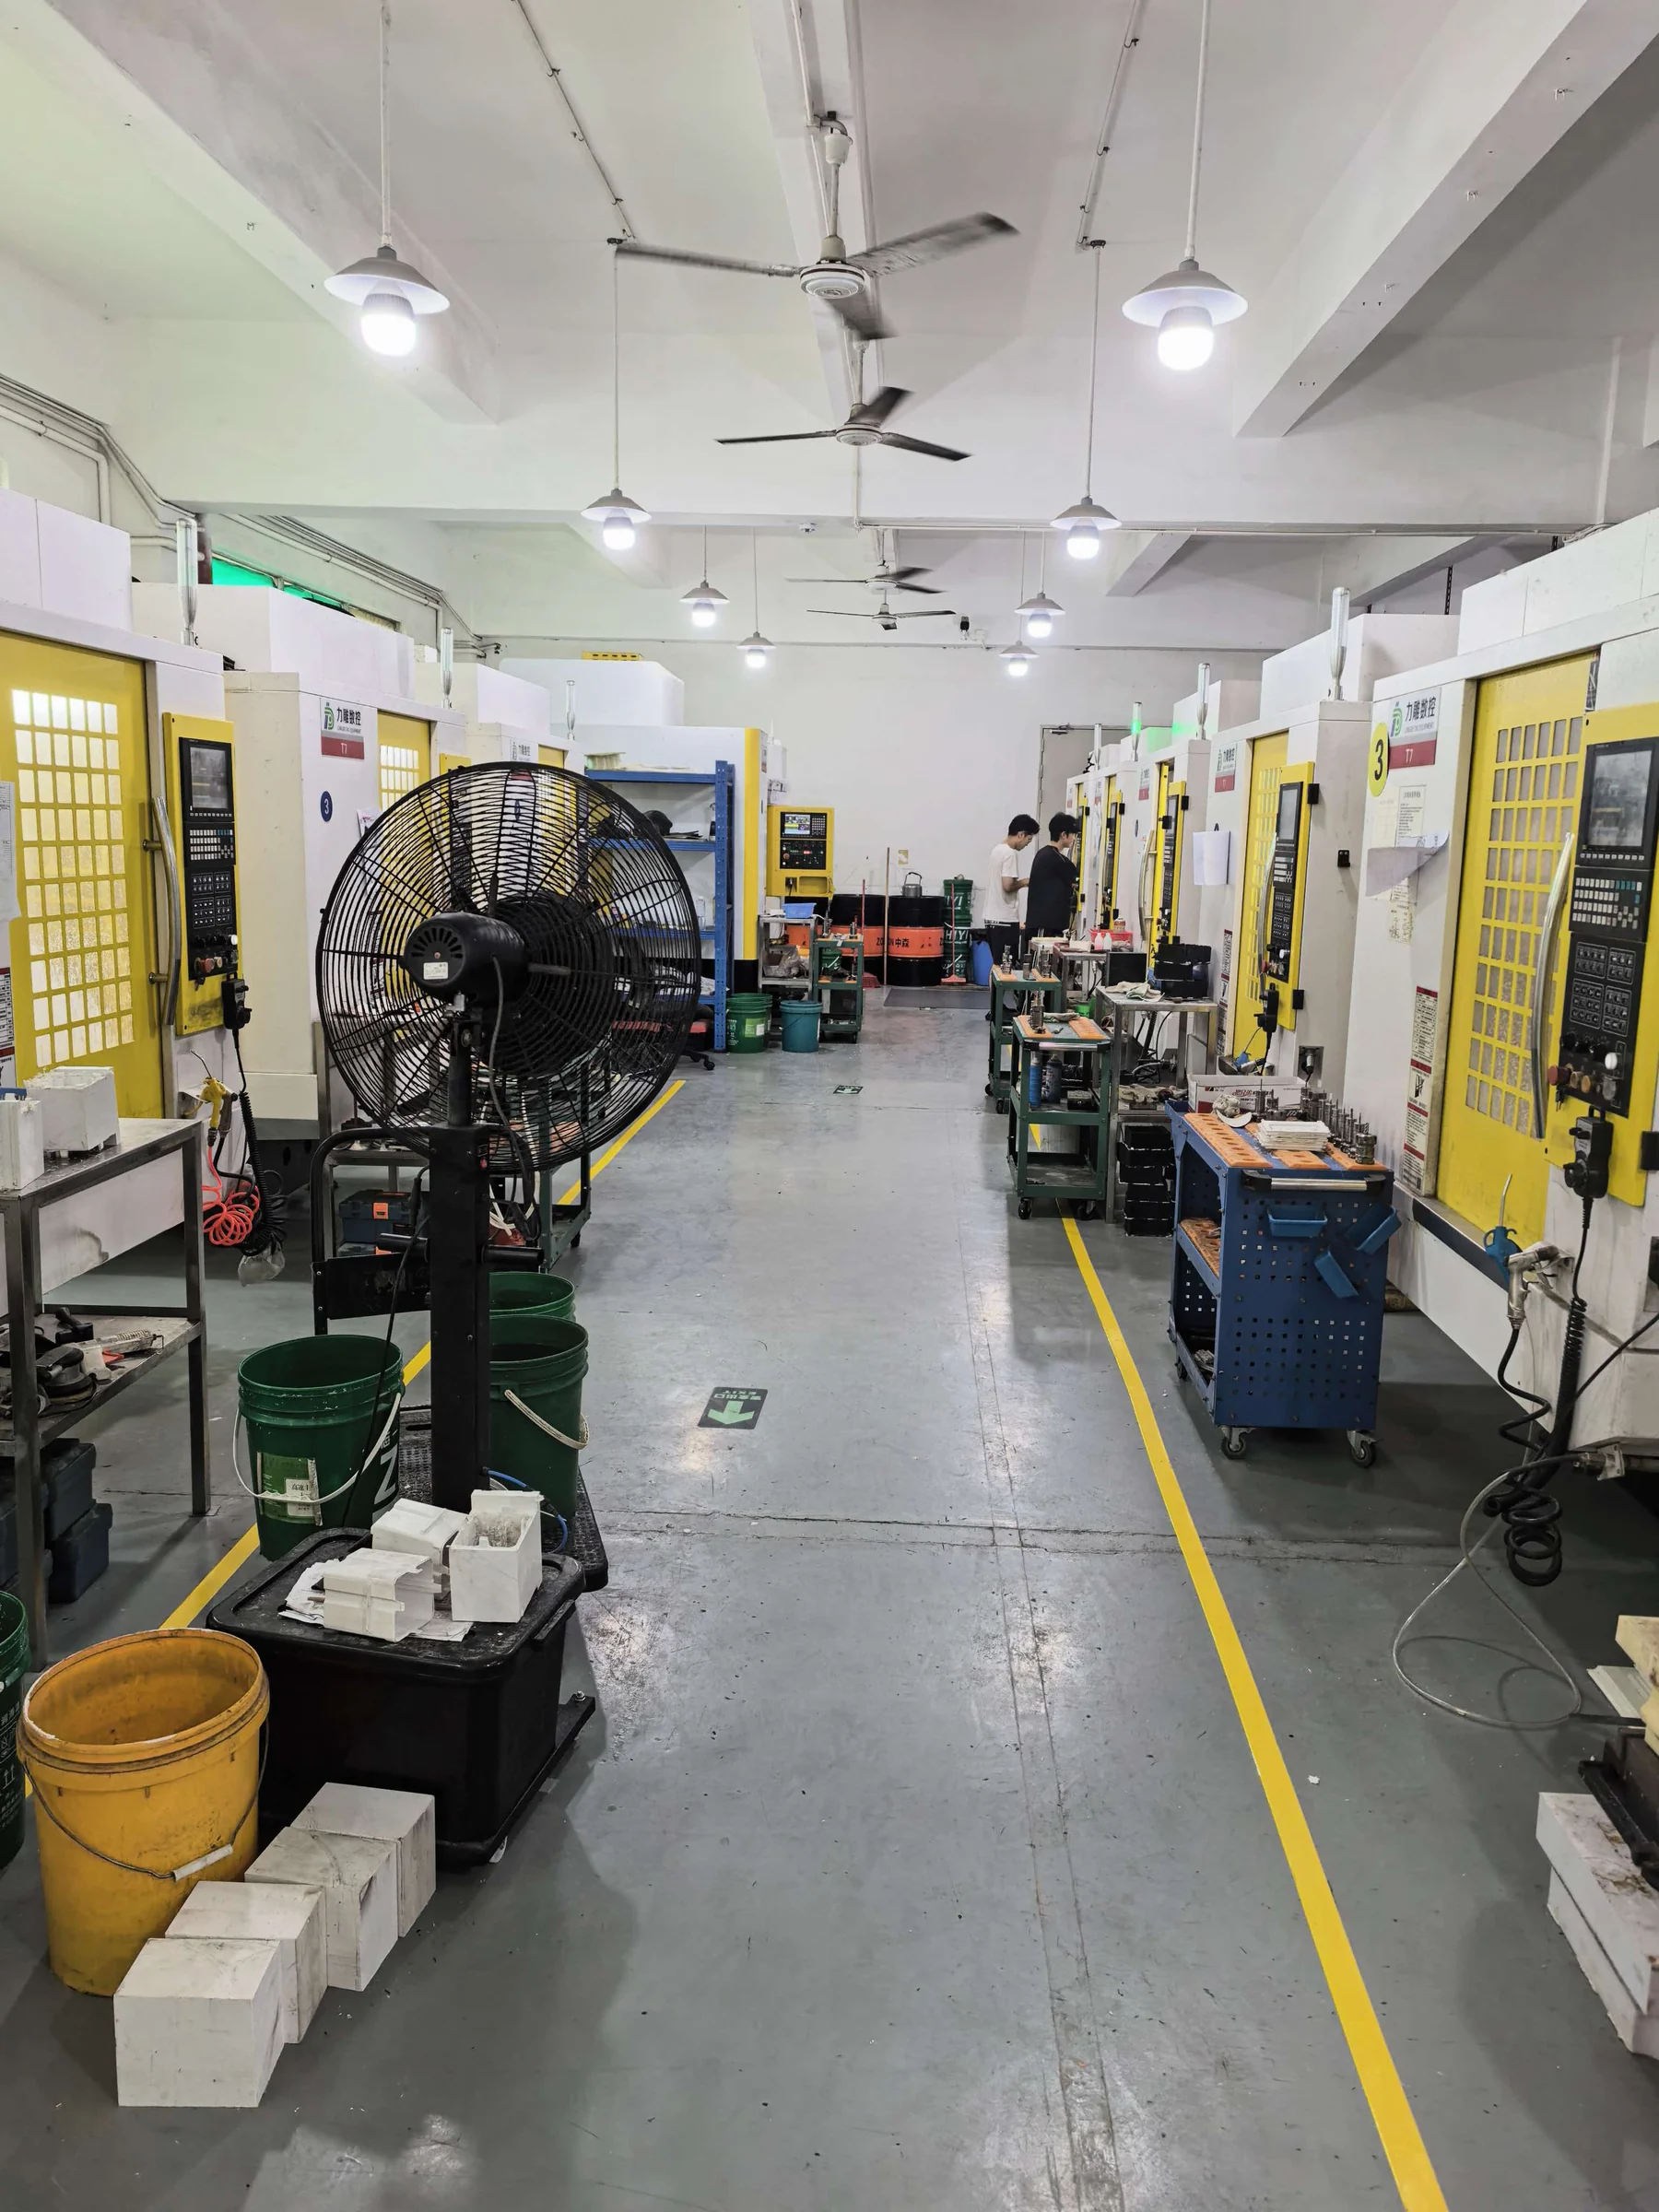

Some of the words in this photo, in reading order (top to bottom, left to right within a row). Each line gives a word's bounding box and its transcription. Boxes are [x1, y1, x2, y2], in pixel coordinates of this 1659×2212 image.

[341, 743, 347, 754] T7
[1406, 748, 1414, 763] T7
[1374, 739, 1383, 781] 3
[324, 798, 329, 814] 3
[895, 937, 910, 947] 中森
[374, 1443, 398, 1505] Z
